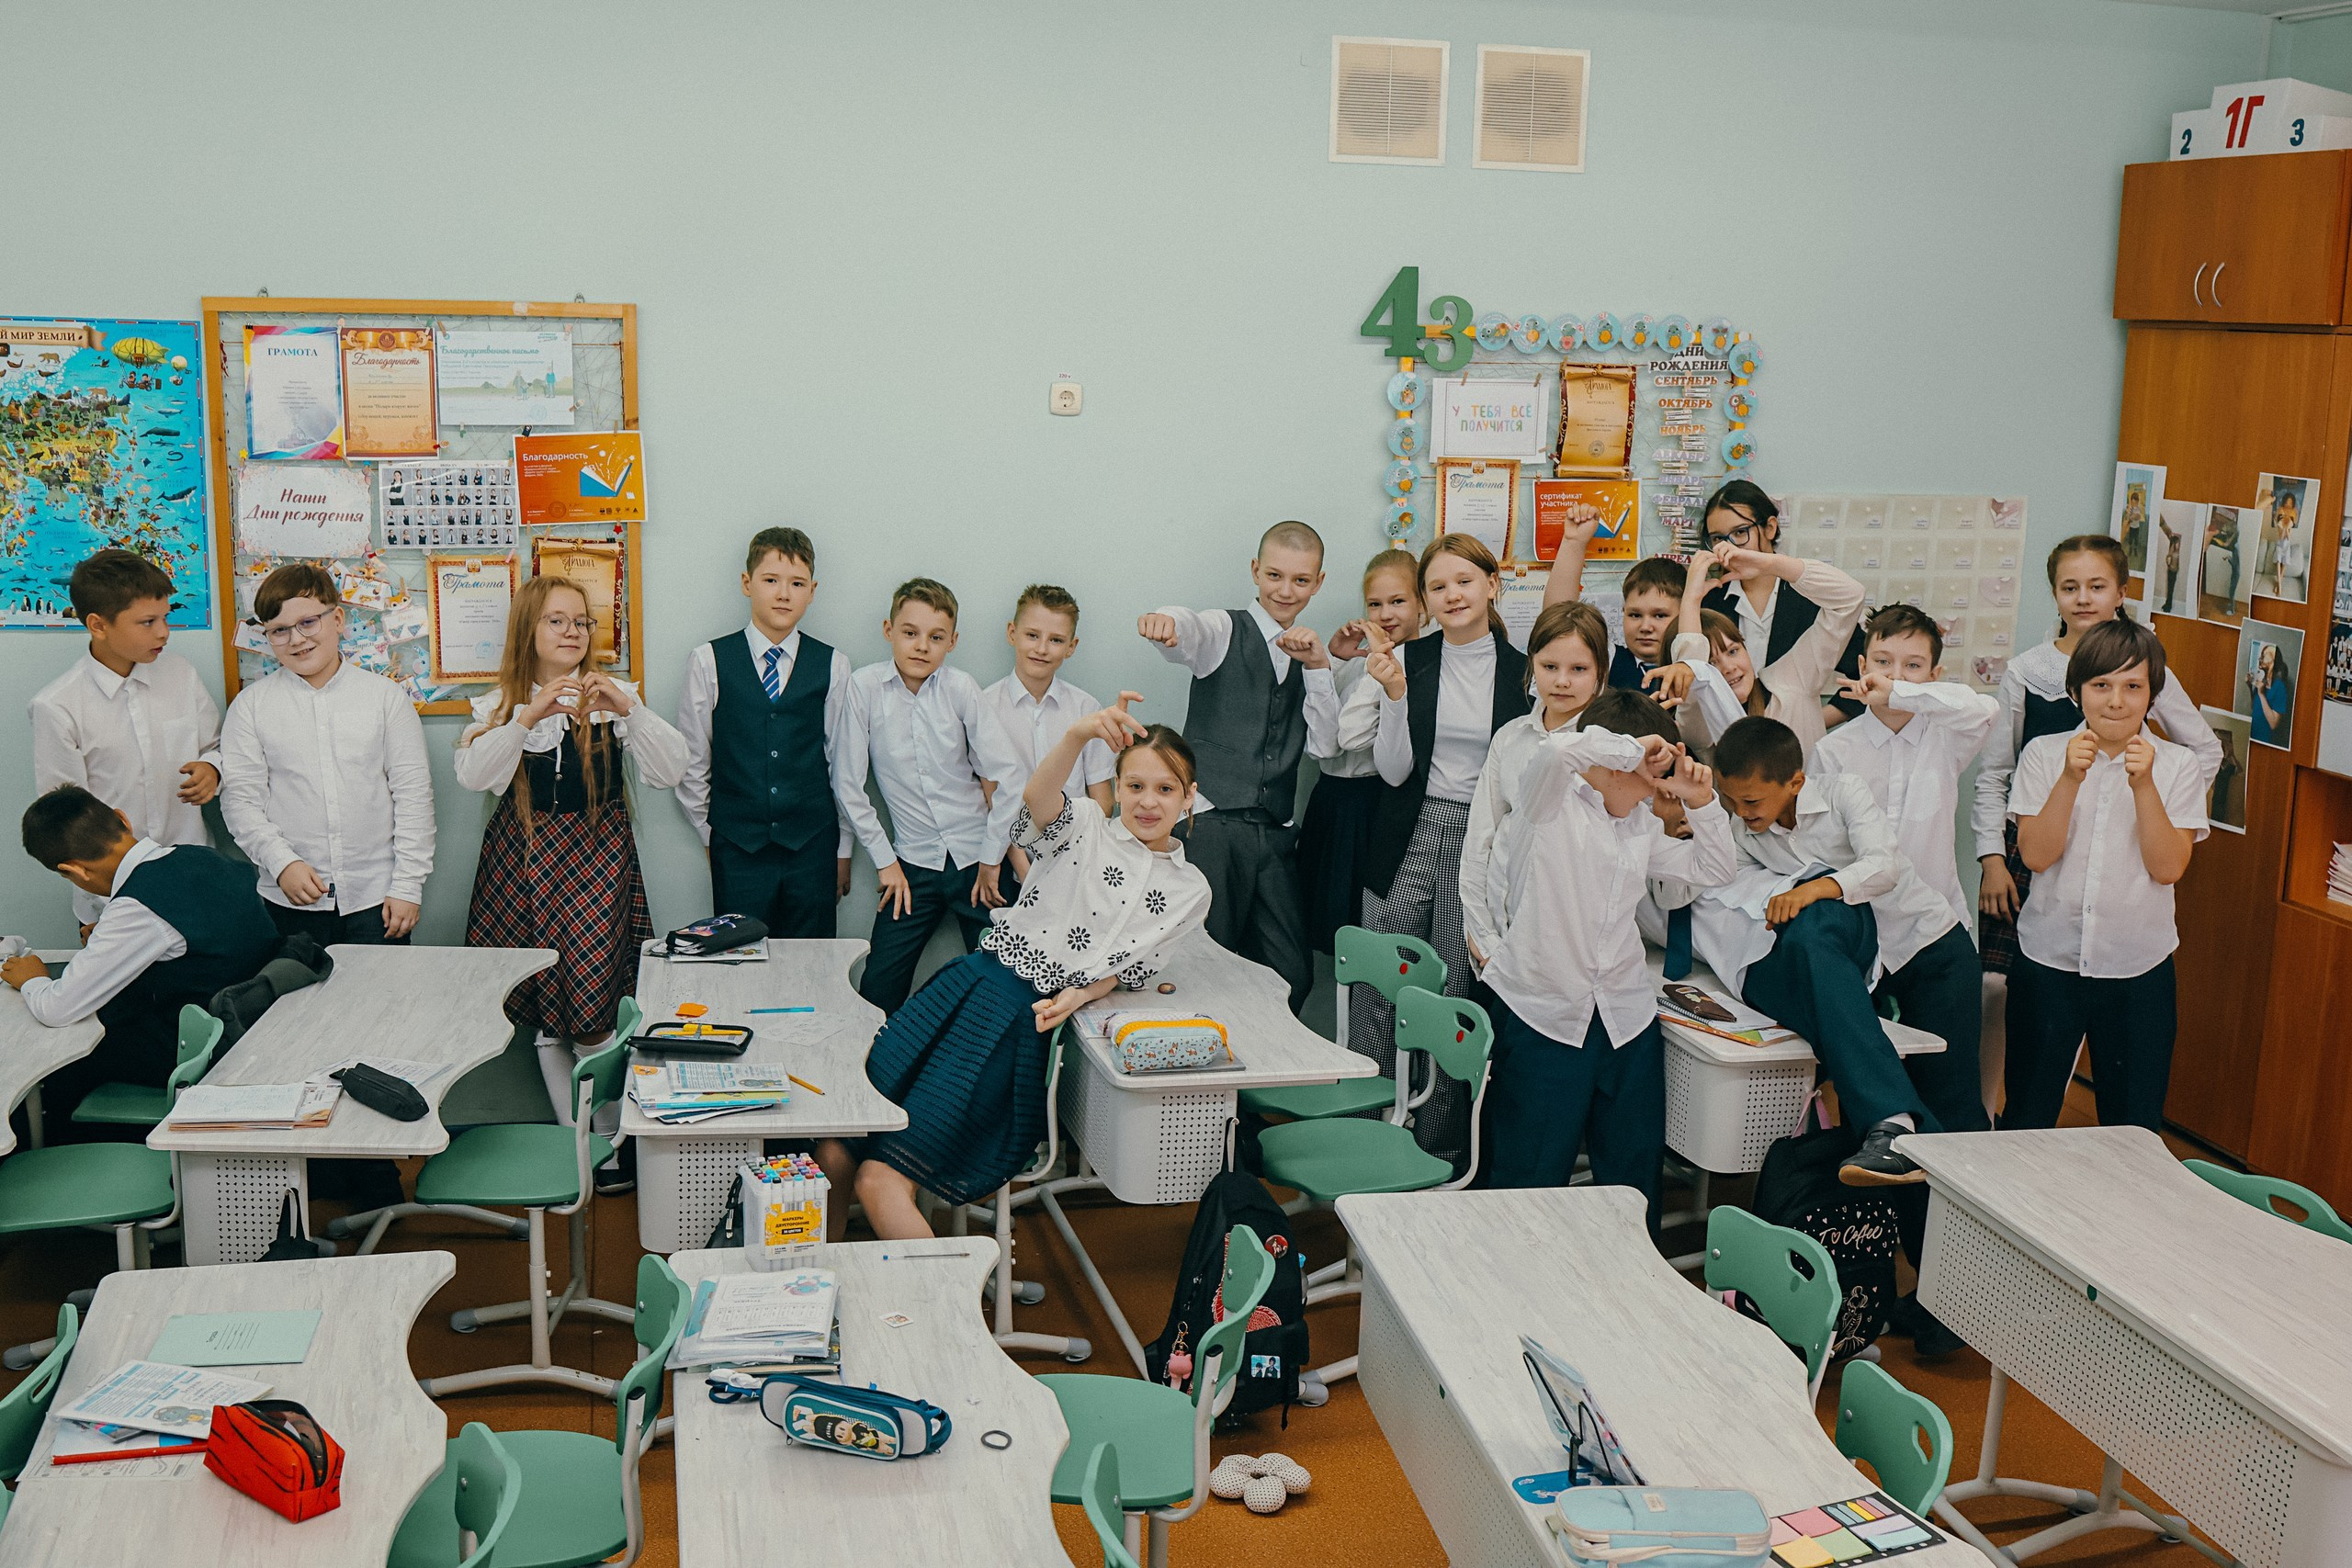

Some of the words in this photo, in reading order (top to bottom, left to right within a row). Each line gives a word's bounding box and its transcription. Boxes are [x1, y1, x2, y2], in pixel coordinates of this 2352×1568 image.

[2290, 118, 2305, 147] 3
[2180, 129, 2192, 155] 2
[11, 331, 34, 340] МИР
[38, 331, 75, 341] ЗЕМЛИ
[267, 347, 318, 357] ГРАМОТА
[352, 352, 421, 369] Благодарность
[1650, 360, 1728, 372] РОЖДЕНИЯ
[1656, 376, 1717, 386] СЕНТЯБРЬ
[1658, 399, 1713, 409] ОКТЯБРЬ
[1452, 405, 1461, 418] У
[1471, 404, 1501, 418] ТЕБЯ
[1461, 420, 1522, 433] ПОЛУЧИТСЯ
[1660, 424, 1706, 435] НОЯБРЬ
[523, 453, 589, 463] Благодарность
[1653, 449, 1711, 462] ДЕКАБРЬ
[1450, 473, 1506, 493] Грамота
[280, 488, 327, 504] Наши
[1540, 491, 1583, 502] сертификат
[1540, 501, 1578, 510] участника
[243, 504, 279, 522] Дни
[281, 510, 365, 528] рождения
[1662, 516, 1696, 527] МАРТ
[442, 573, 506, 594] Грамота
[1843, 1224, 1883, 1250] Coffee
